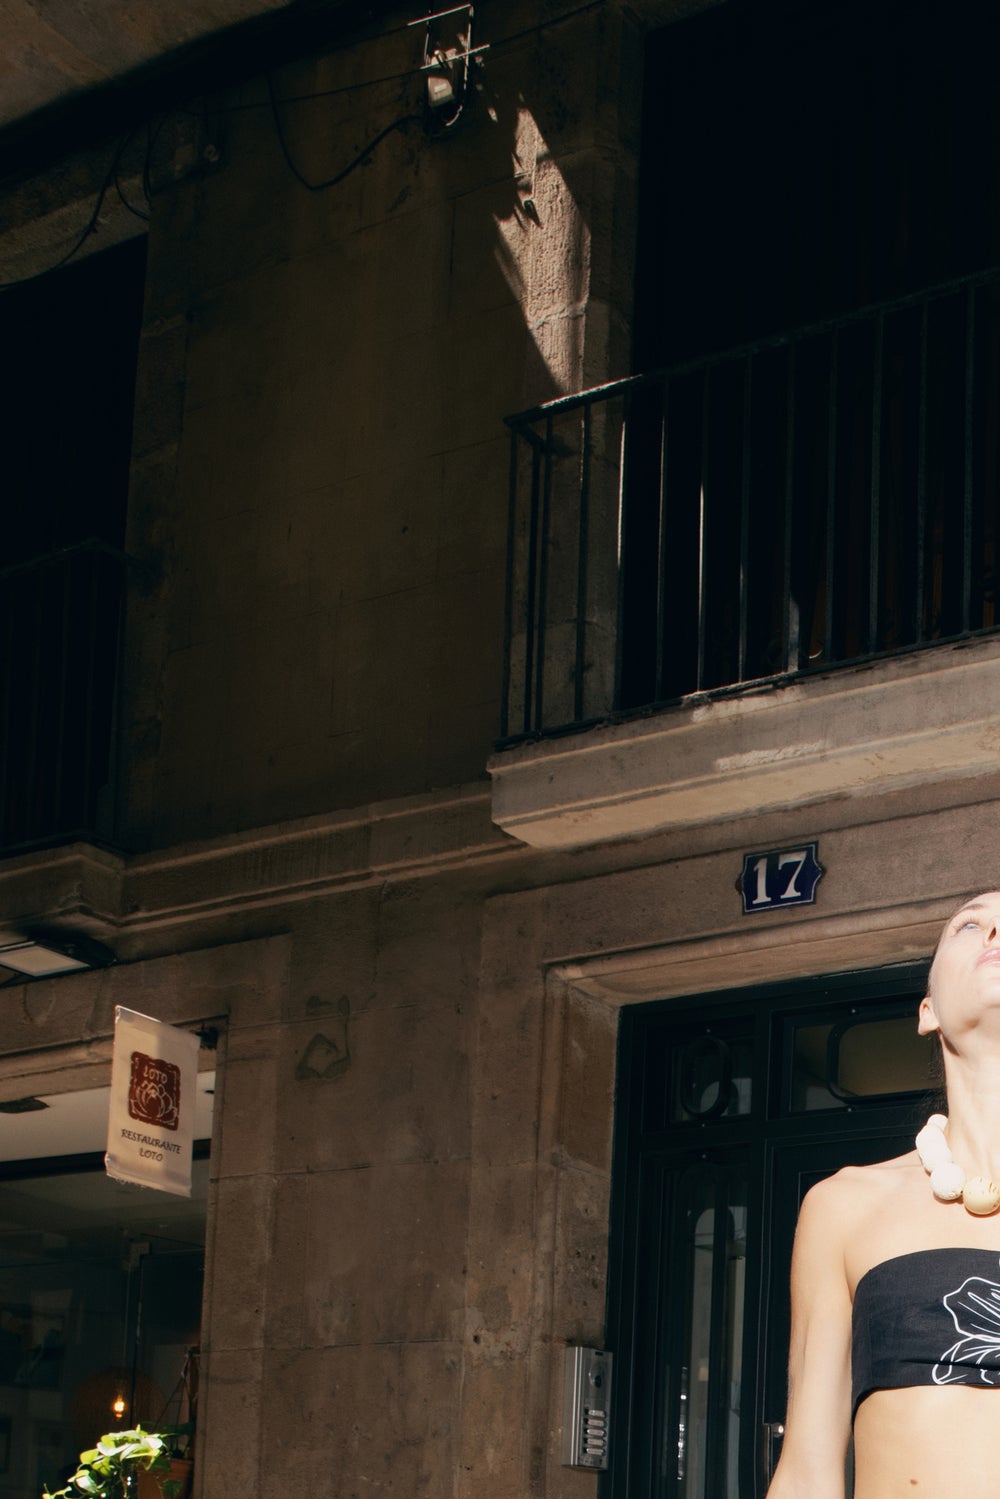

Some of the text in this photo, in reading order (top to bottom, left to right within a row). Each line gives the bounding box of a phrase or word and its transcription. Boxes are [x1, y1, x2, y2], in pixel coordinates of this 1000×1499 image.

[751, 850, 807, 905] 17
[143, 1065, 168, 1085] LOTO
[121, 1128, 182, 1154] RESTAURANTE
[139, 1147, 164, 1162] LOTO
